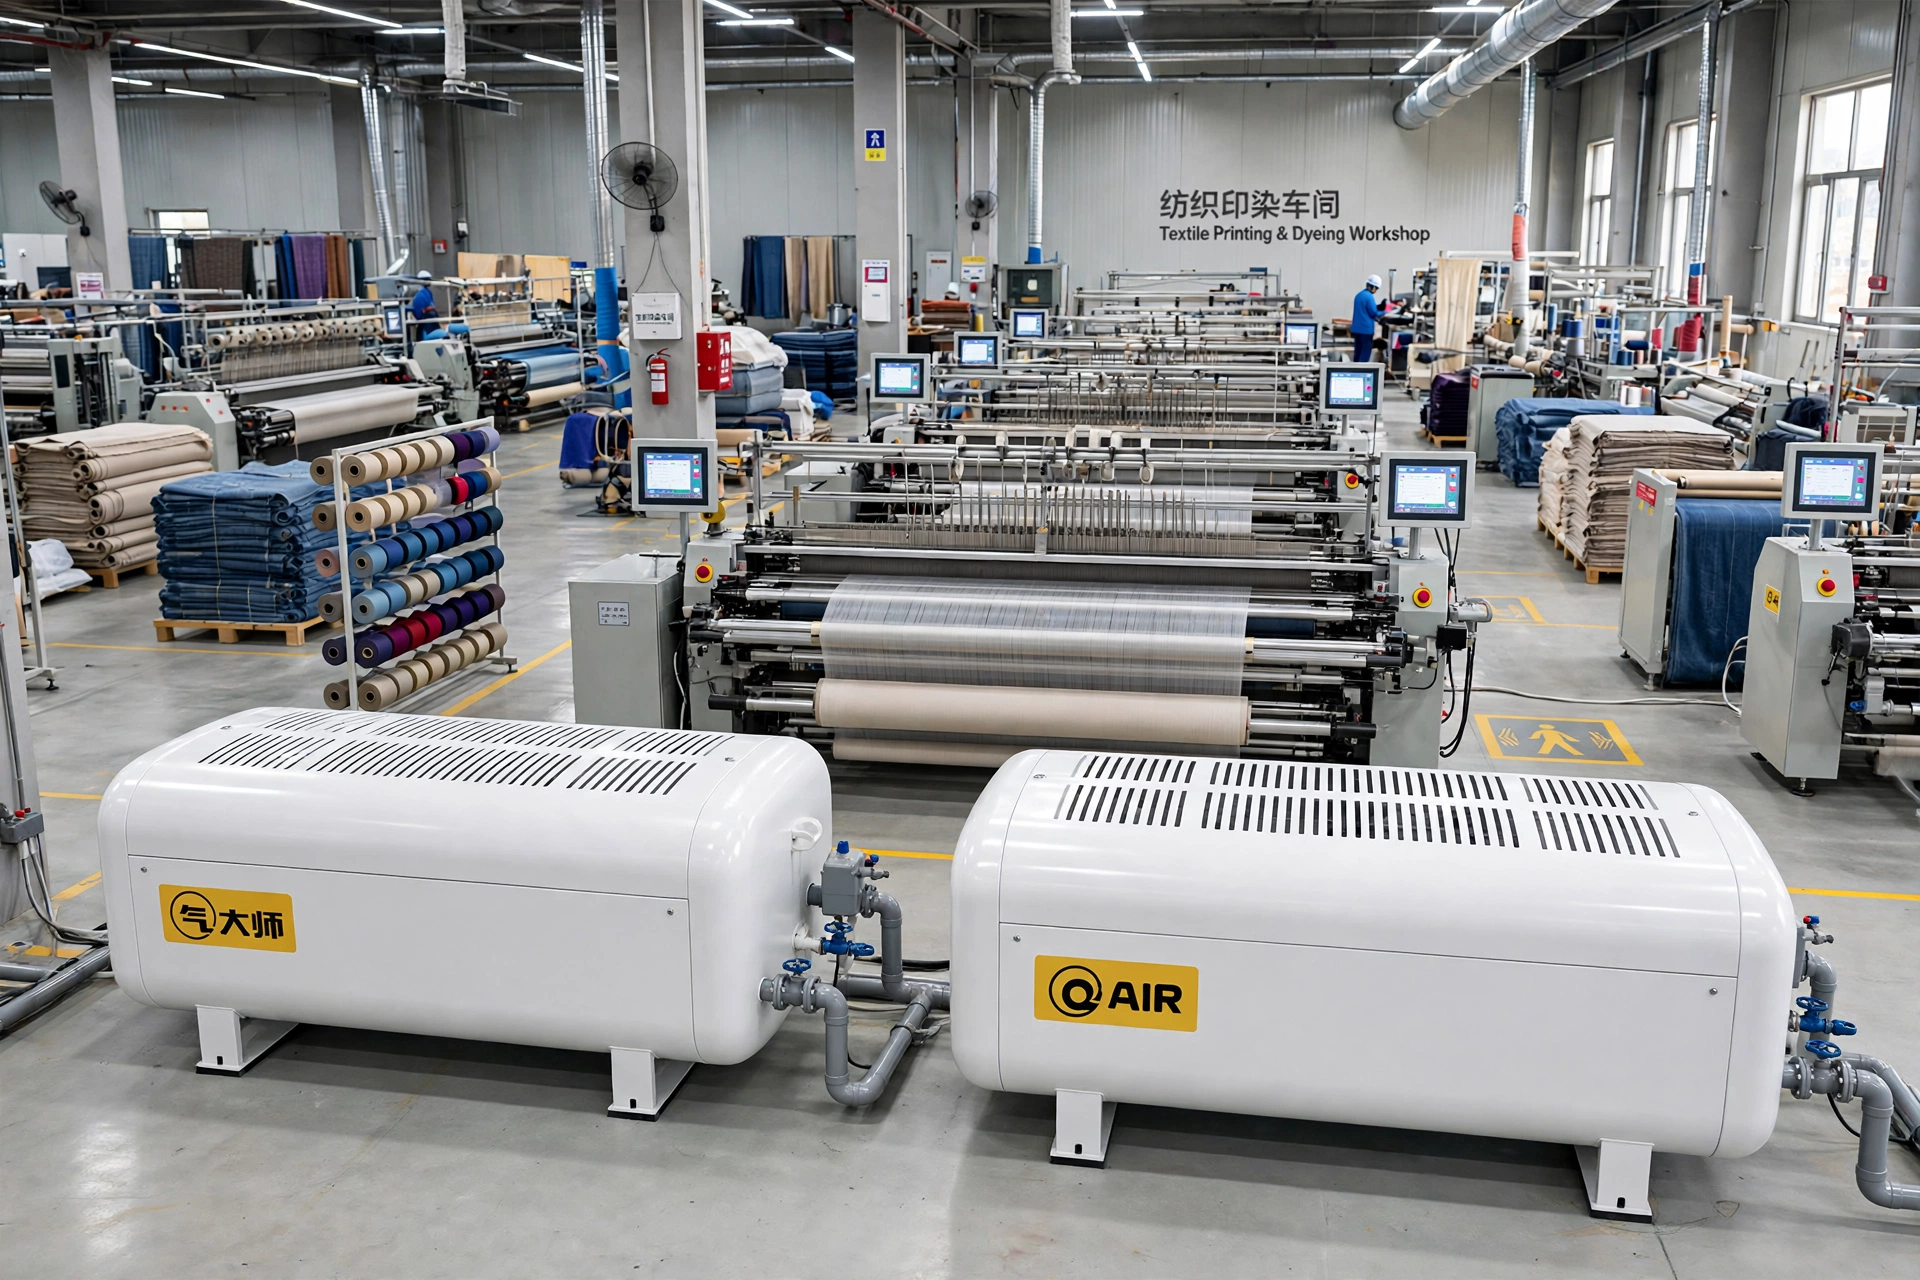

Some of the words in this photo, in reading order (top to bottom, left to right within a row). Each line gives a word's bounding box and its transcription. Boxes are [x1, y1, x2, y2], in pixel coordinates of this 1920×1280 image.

[1159, 189, 1340, 219] 纺织印染车间
[1159, 226, 1210, 241] Textile
[1213, 225, 1272, 245] Printing
[1276, 226, 1288, 241] &
[1292, 225, 1345, 245] Dyeing
[1349, 225, 1431, 245] Workshop
[170, 891, 284, 940] 气大师
